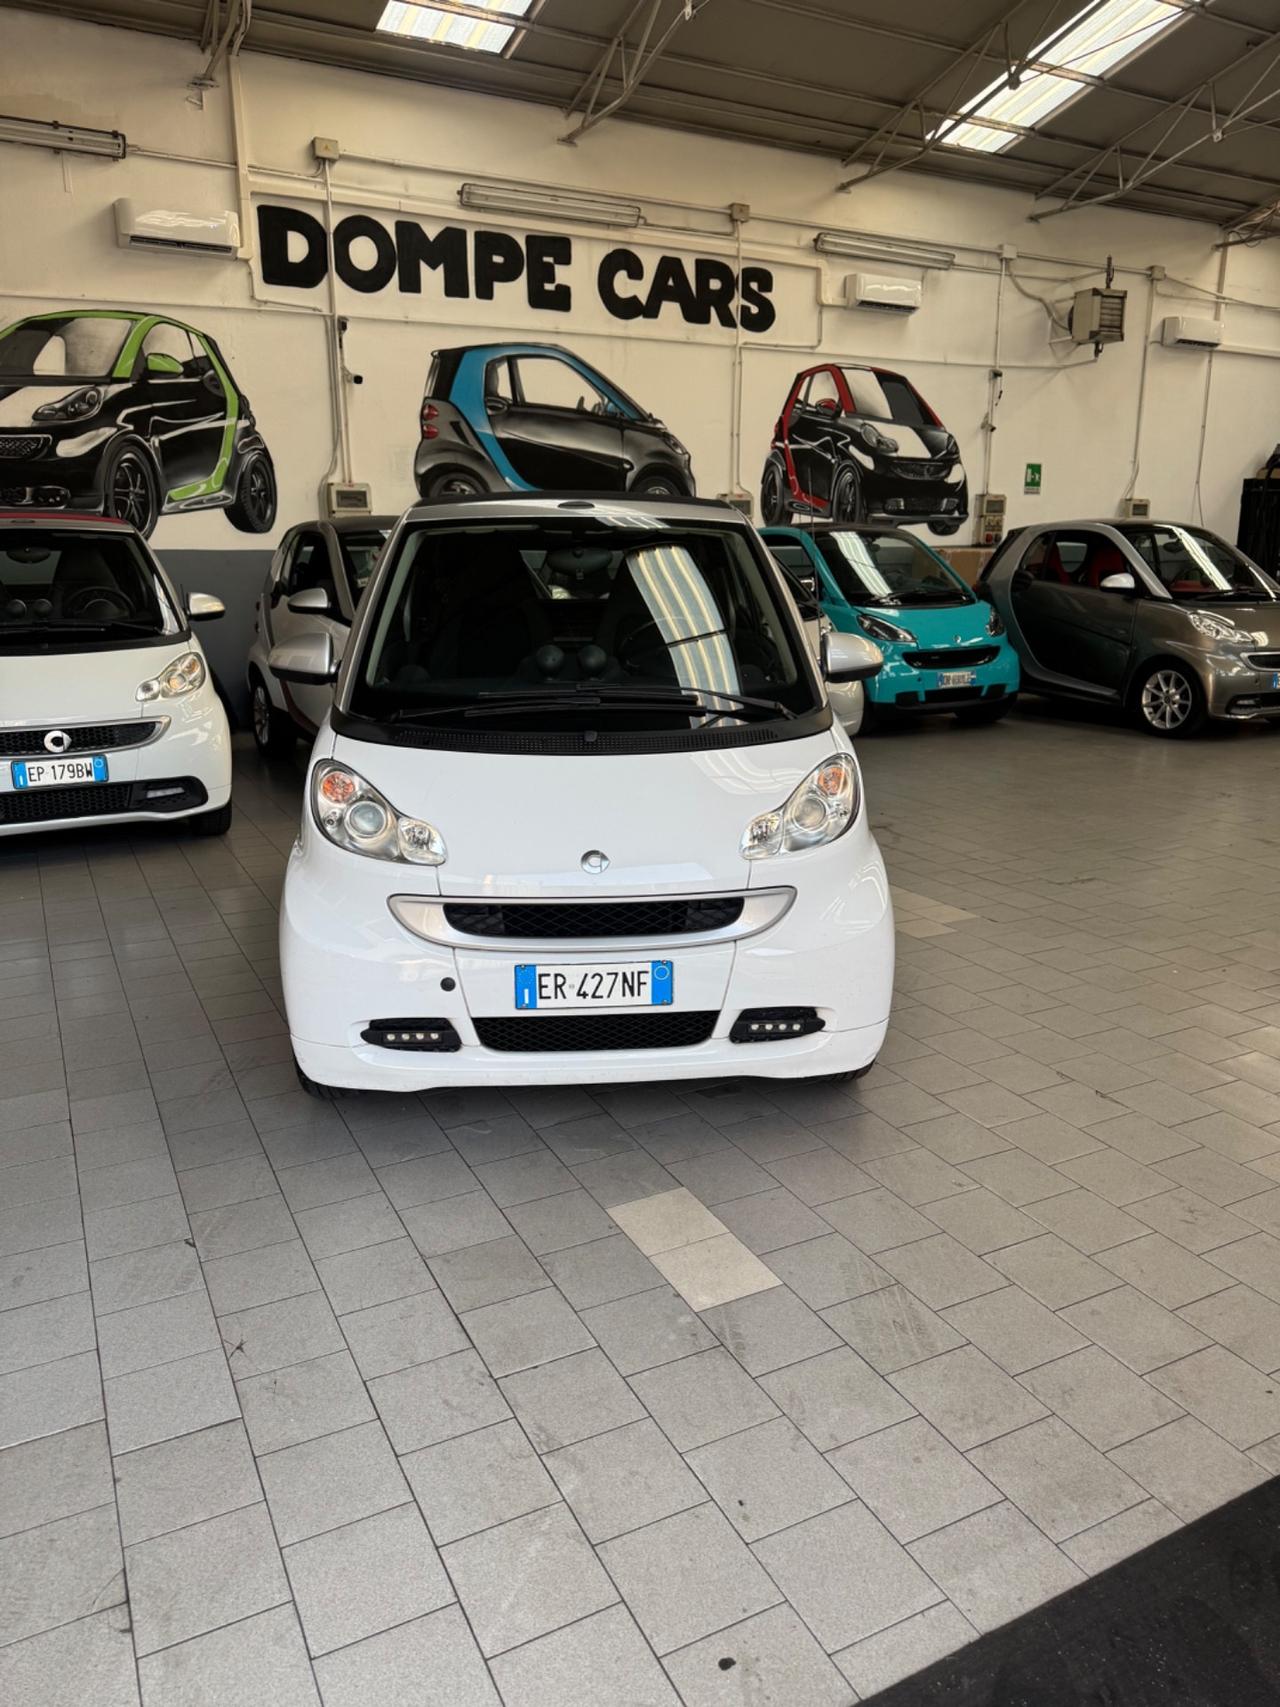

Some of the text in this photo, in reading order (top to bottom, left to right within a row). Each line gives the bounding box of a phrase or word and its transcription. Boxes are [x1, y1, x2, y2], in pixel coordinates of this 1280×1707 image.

[257, 204, 776, 333] DOMPE CARS
[28, 762, 93, 782] EP 179BW
[538, 970, 649, 999] ER 427NF
